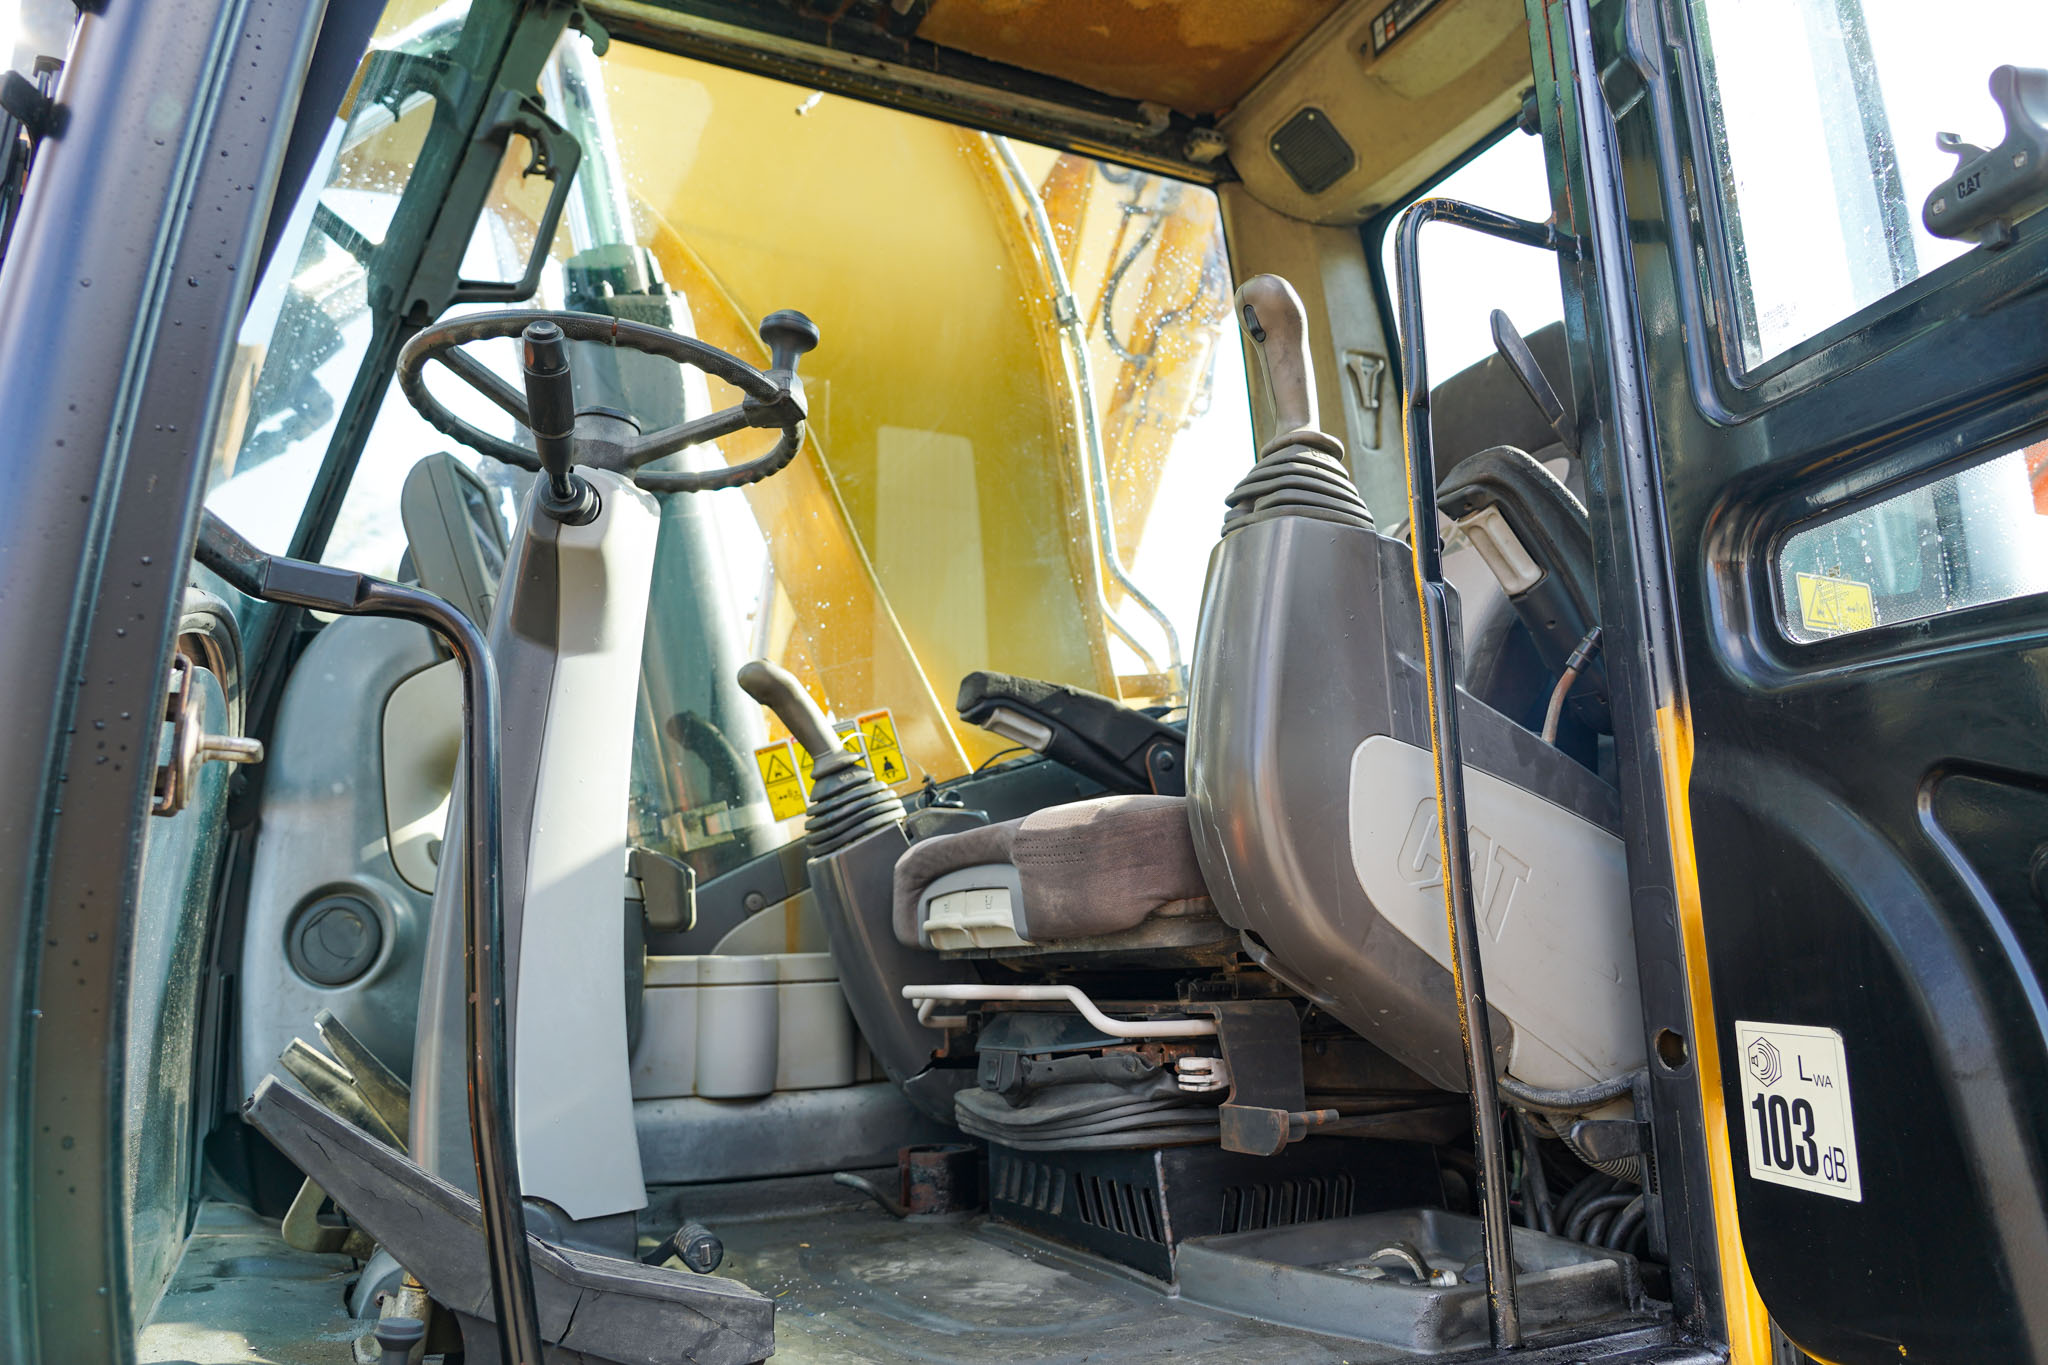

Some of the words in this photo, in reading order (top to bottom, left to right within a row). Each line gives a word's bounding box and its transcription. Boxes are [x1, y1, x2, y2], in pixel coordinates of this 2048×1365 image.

[1957, 172, 1981, 199] CAT
[1752, 1093, 1819, 1176] 103
[1823, 1146, 1848, 1182] dB
